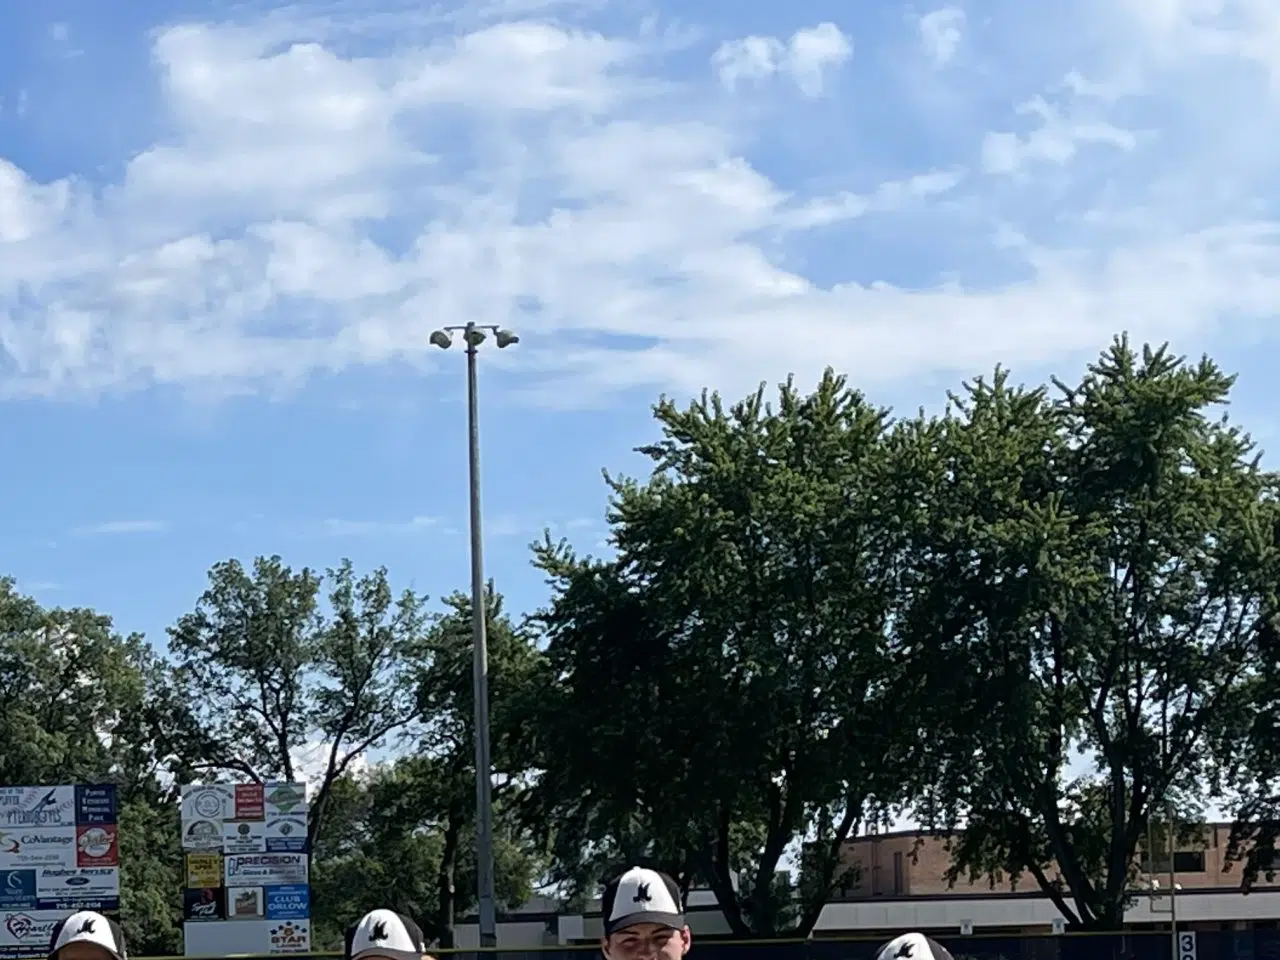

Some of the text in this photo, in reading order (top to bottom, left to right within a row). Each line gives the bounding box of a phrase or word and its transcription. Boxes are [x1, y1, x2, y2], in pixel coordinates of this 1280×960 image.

[21, 835, 73, 845] CoVantage
[235, 855, 301, 870] PRECISION
[273, 895, 302, 904] CLUB
[267, 902, 308, 911] ORLOW
